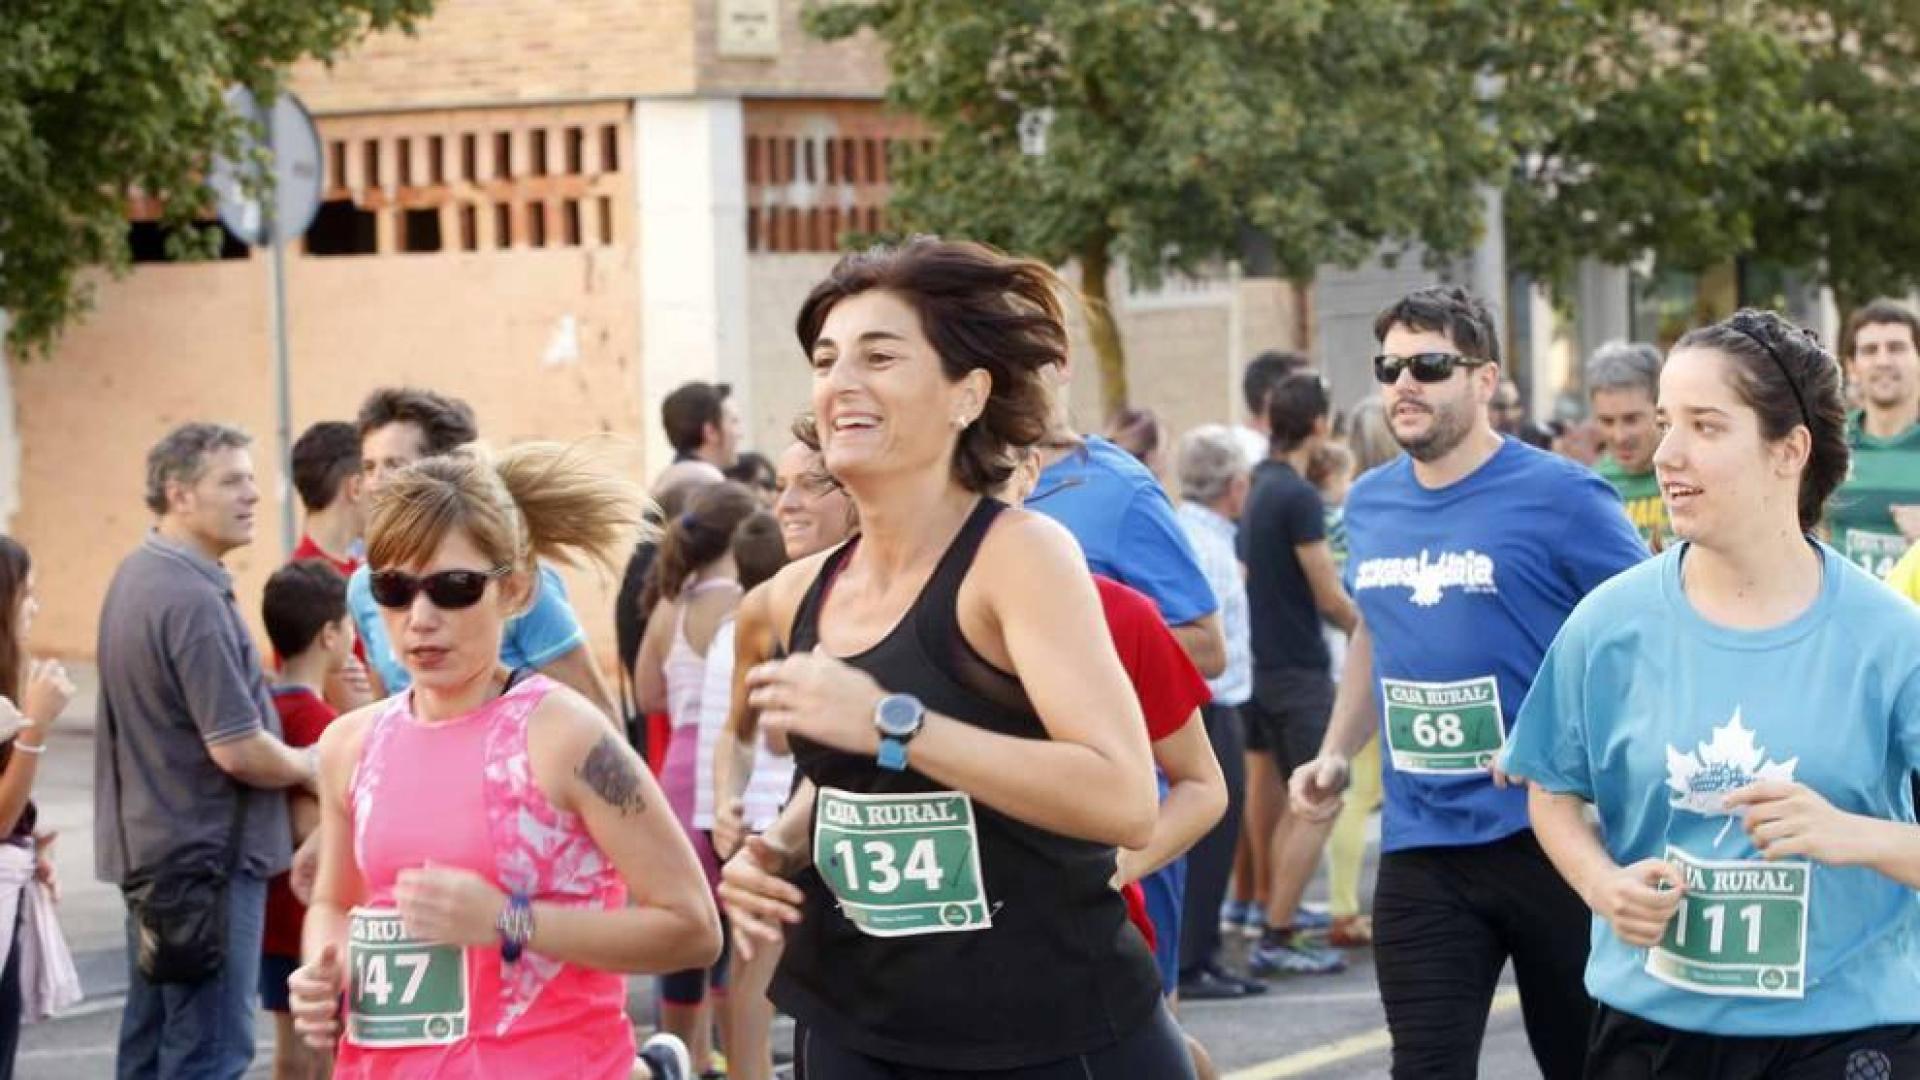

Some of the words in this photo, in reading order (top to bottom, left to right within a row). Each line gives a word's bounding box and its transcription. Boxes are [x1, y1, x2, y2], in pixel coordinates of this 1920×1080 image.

[1426, 685, 1489, 705] RURAL
[1412, 712, 1465, 748] 68
[866, 802, 958, 826] RURAL
[833, 838, 944, 893] 134
[1713, 869, 1794, 892] RURAL
[1675, 900, 1762, 954] 111
[356, 952, 432, 1006] 147
